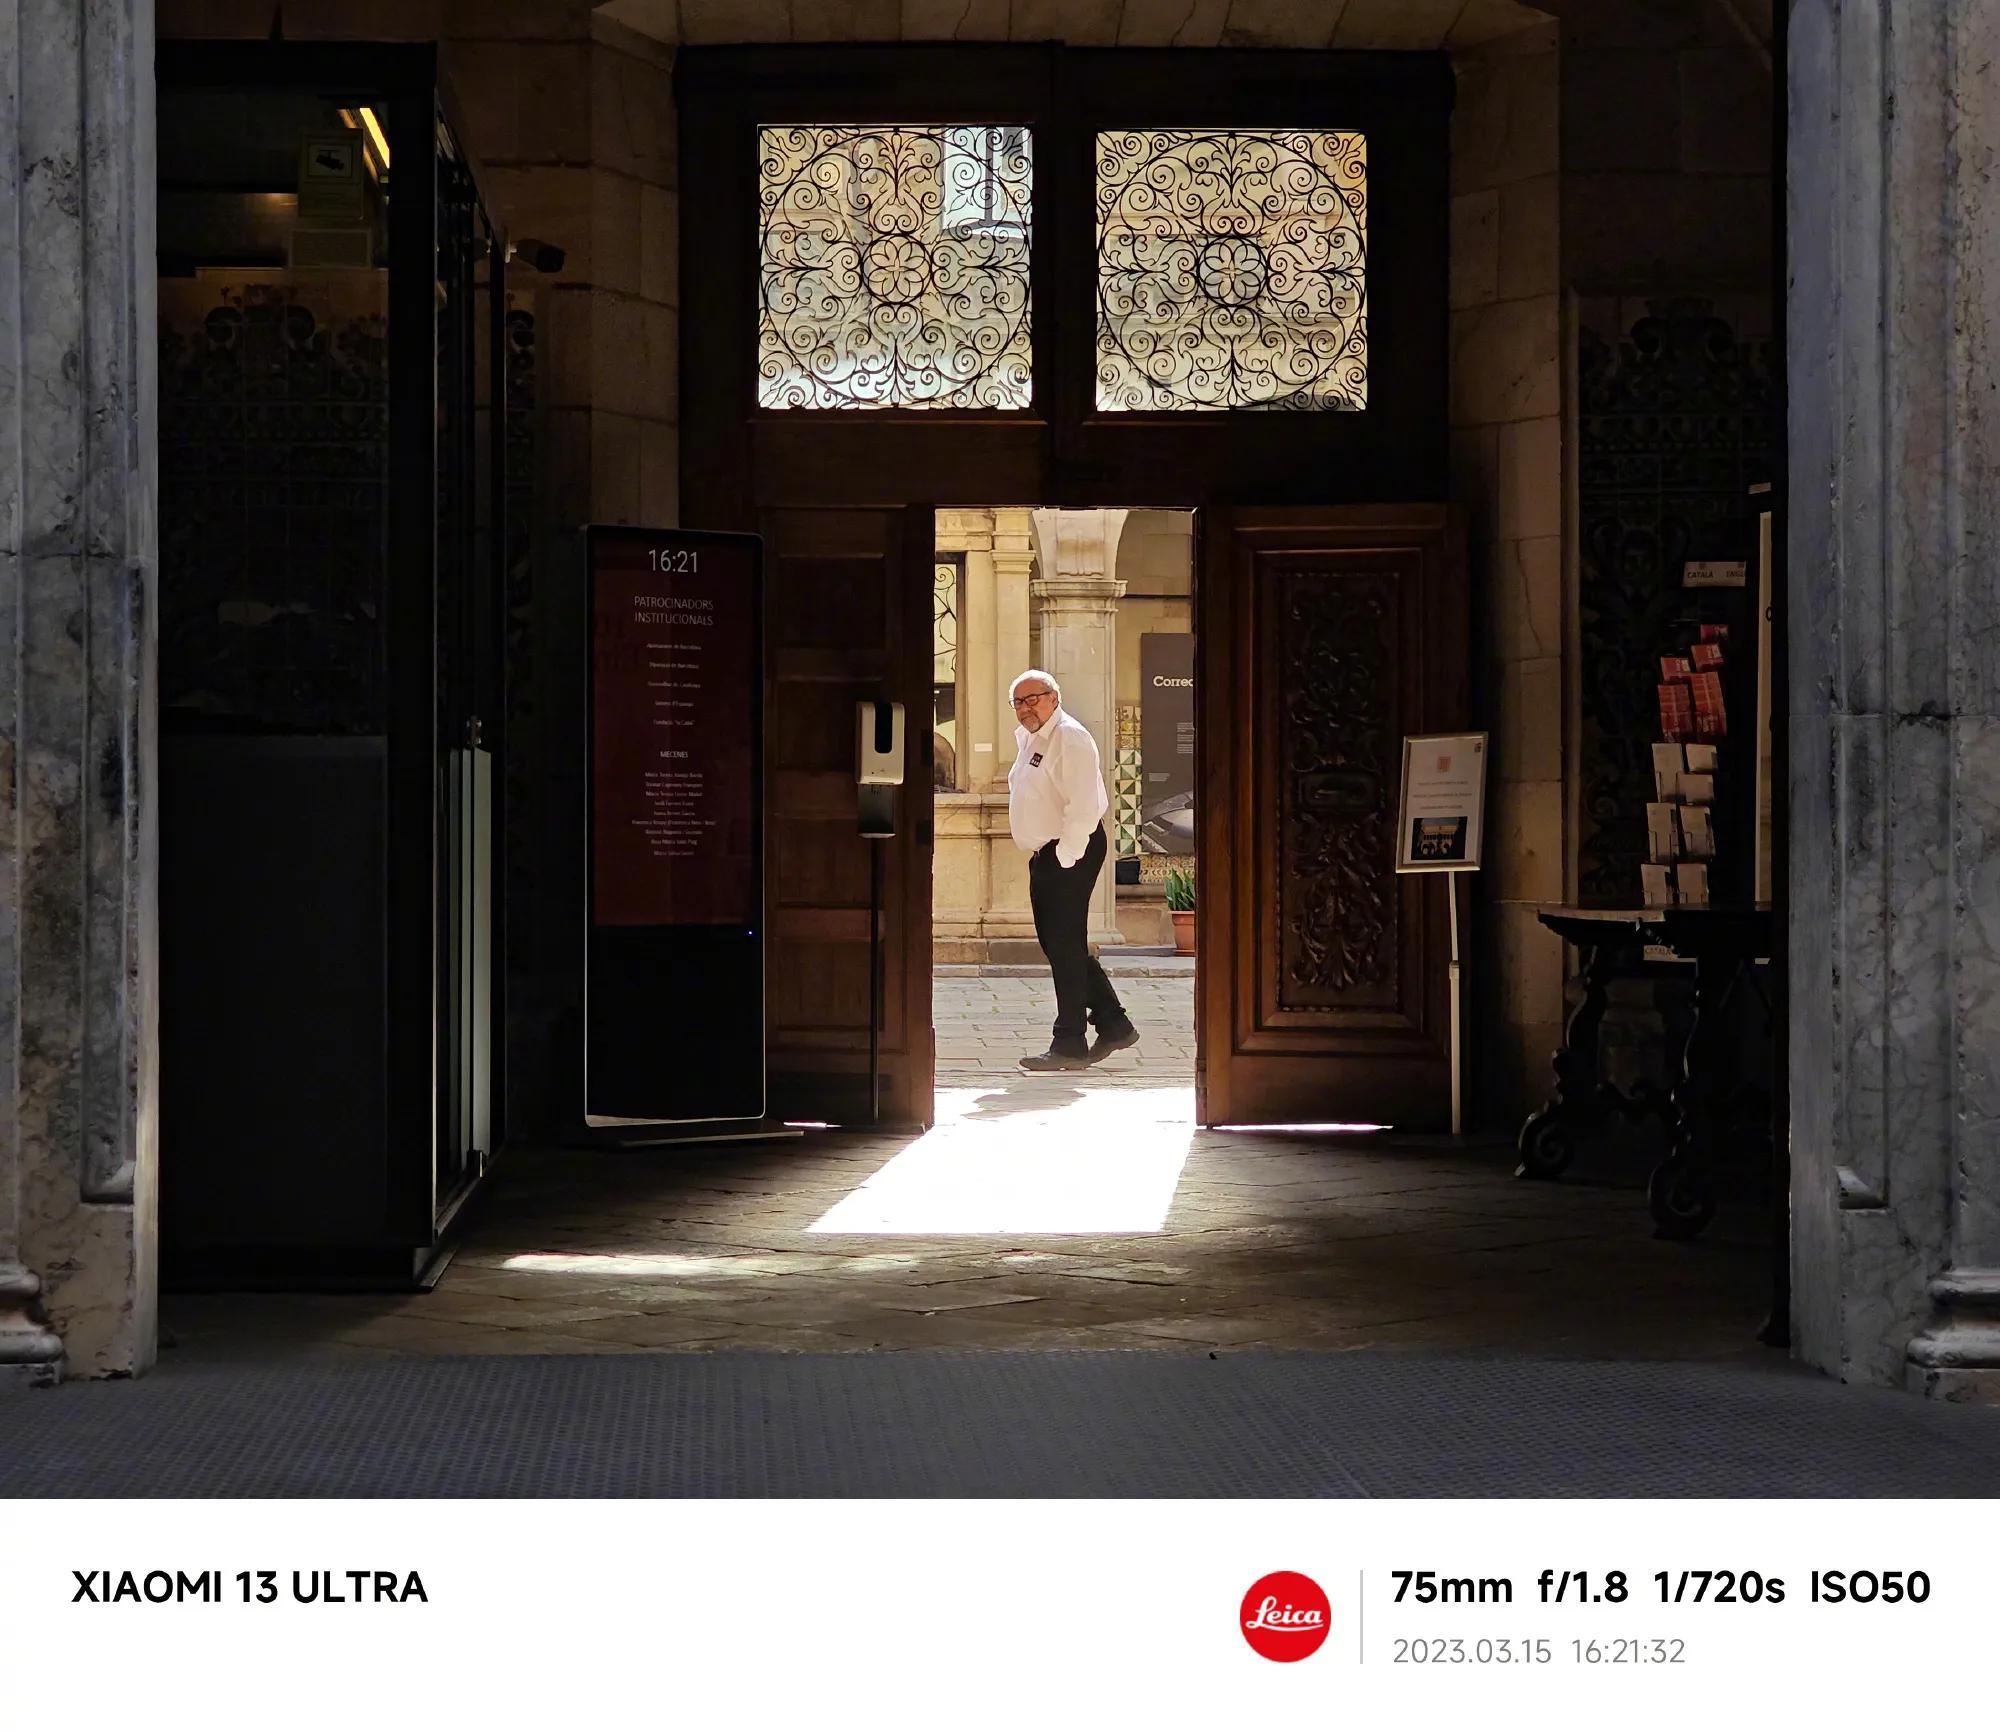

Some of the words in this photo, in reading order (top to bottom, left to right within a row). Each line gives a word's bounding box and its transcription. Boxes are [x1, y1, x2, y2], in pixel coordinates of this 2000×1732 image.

[648, 549, 698, 573] 16:21
[634, 596, 714, 610] PATROCINADORS
[634, 611, 714, 626] INSTITUCIONALS
